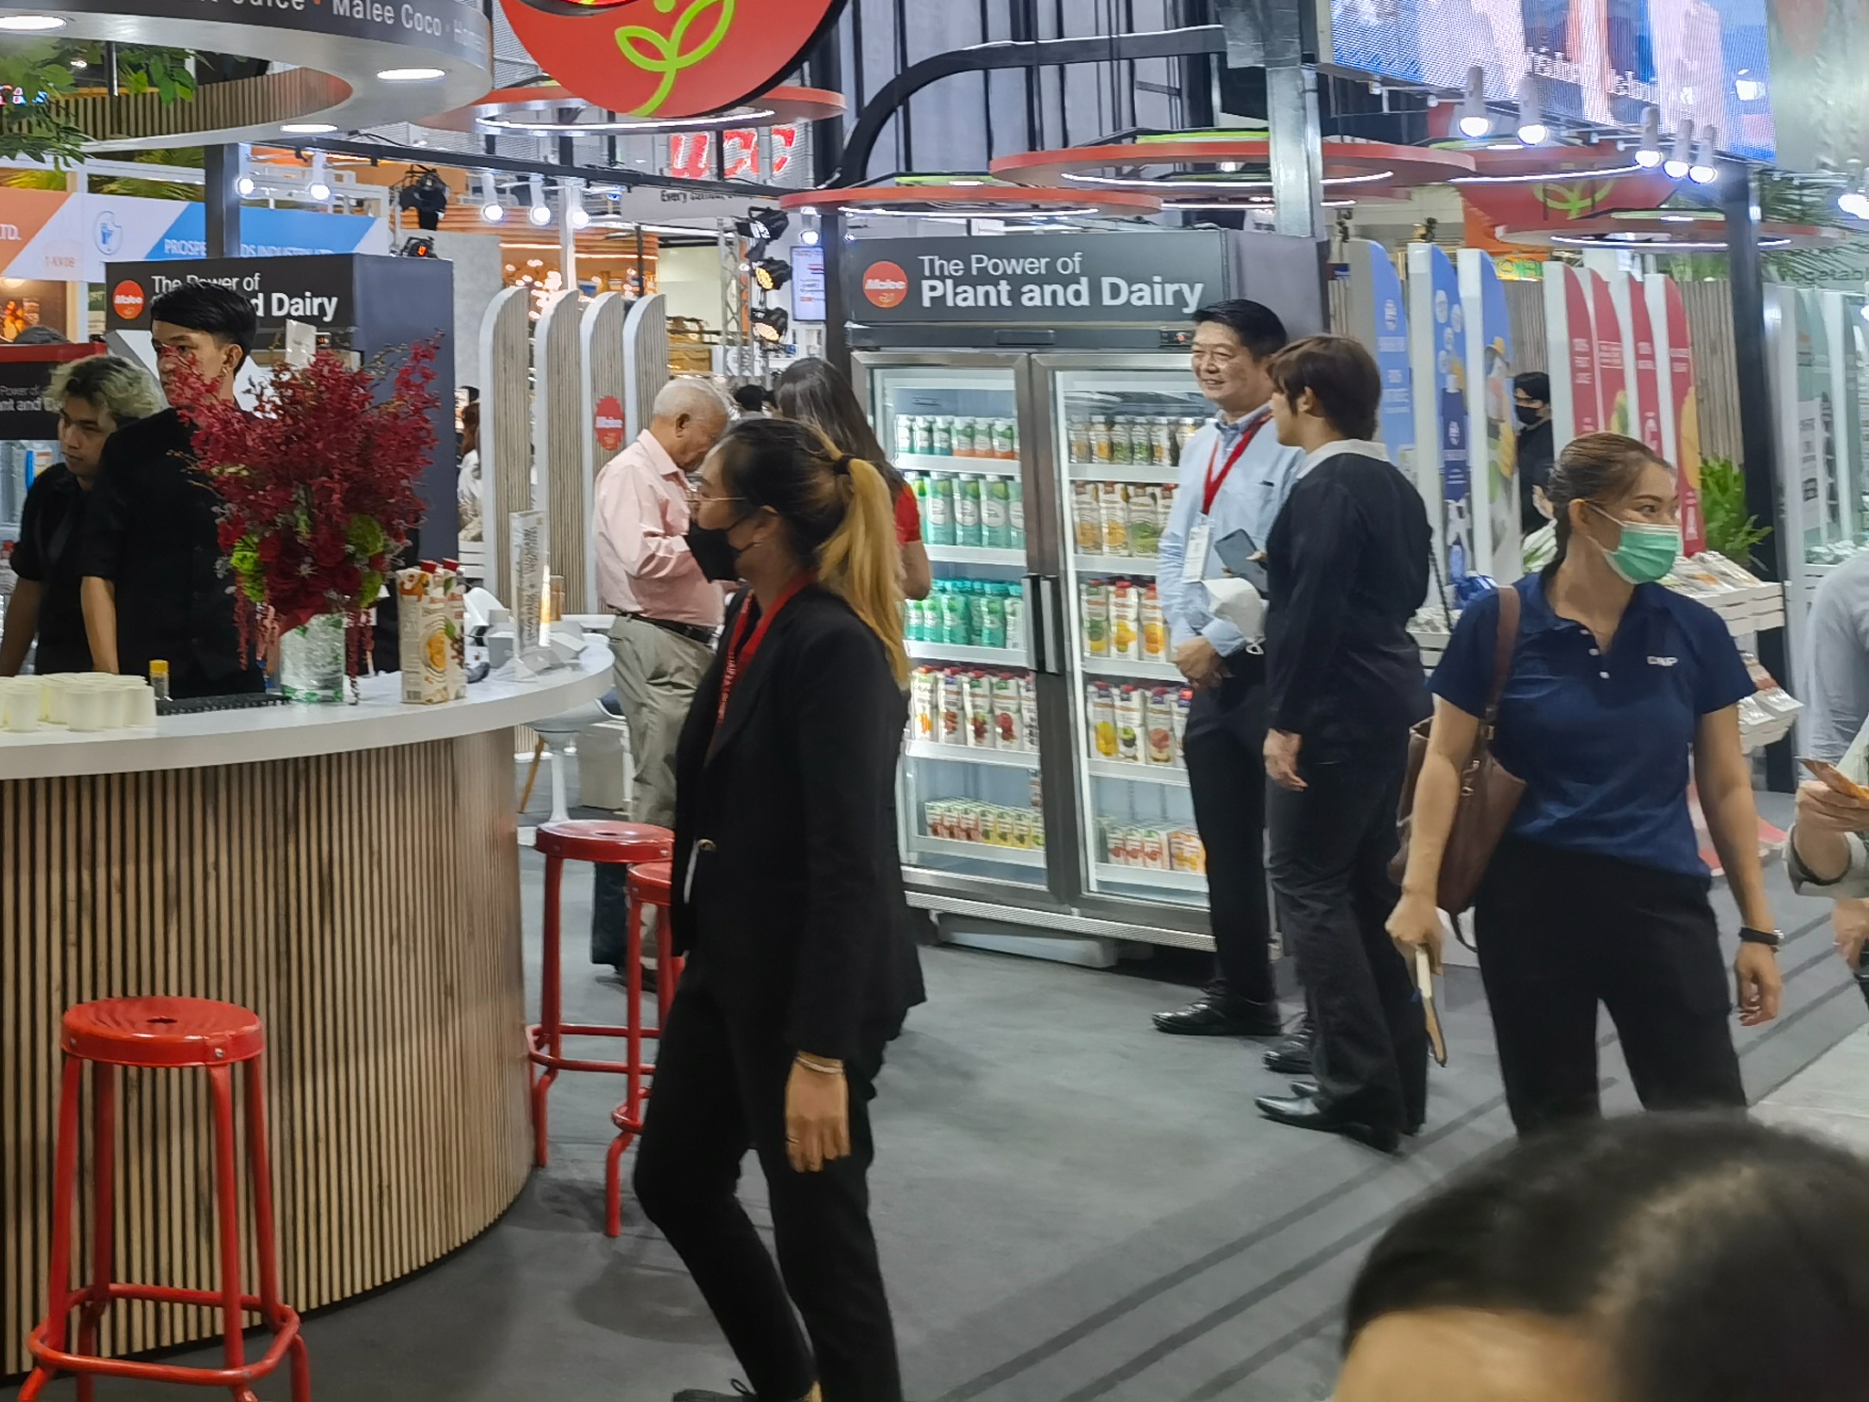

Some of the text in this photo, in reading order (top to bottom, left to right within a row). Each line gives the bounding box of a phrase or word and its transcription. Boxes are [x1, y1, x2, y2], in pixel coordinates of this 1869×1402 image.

[401, 3, 442, 36] Coco
[917, 252, 1083, 277] The Power of
[151, 275, 181, 293] The
[242, 273, 261, 292] of
[921, 275, 1205, 314] Plant and Dairy
[271, 292, 338, 322] Dairy
[16, 398, 42, 412] and
